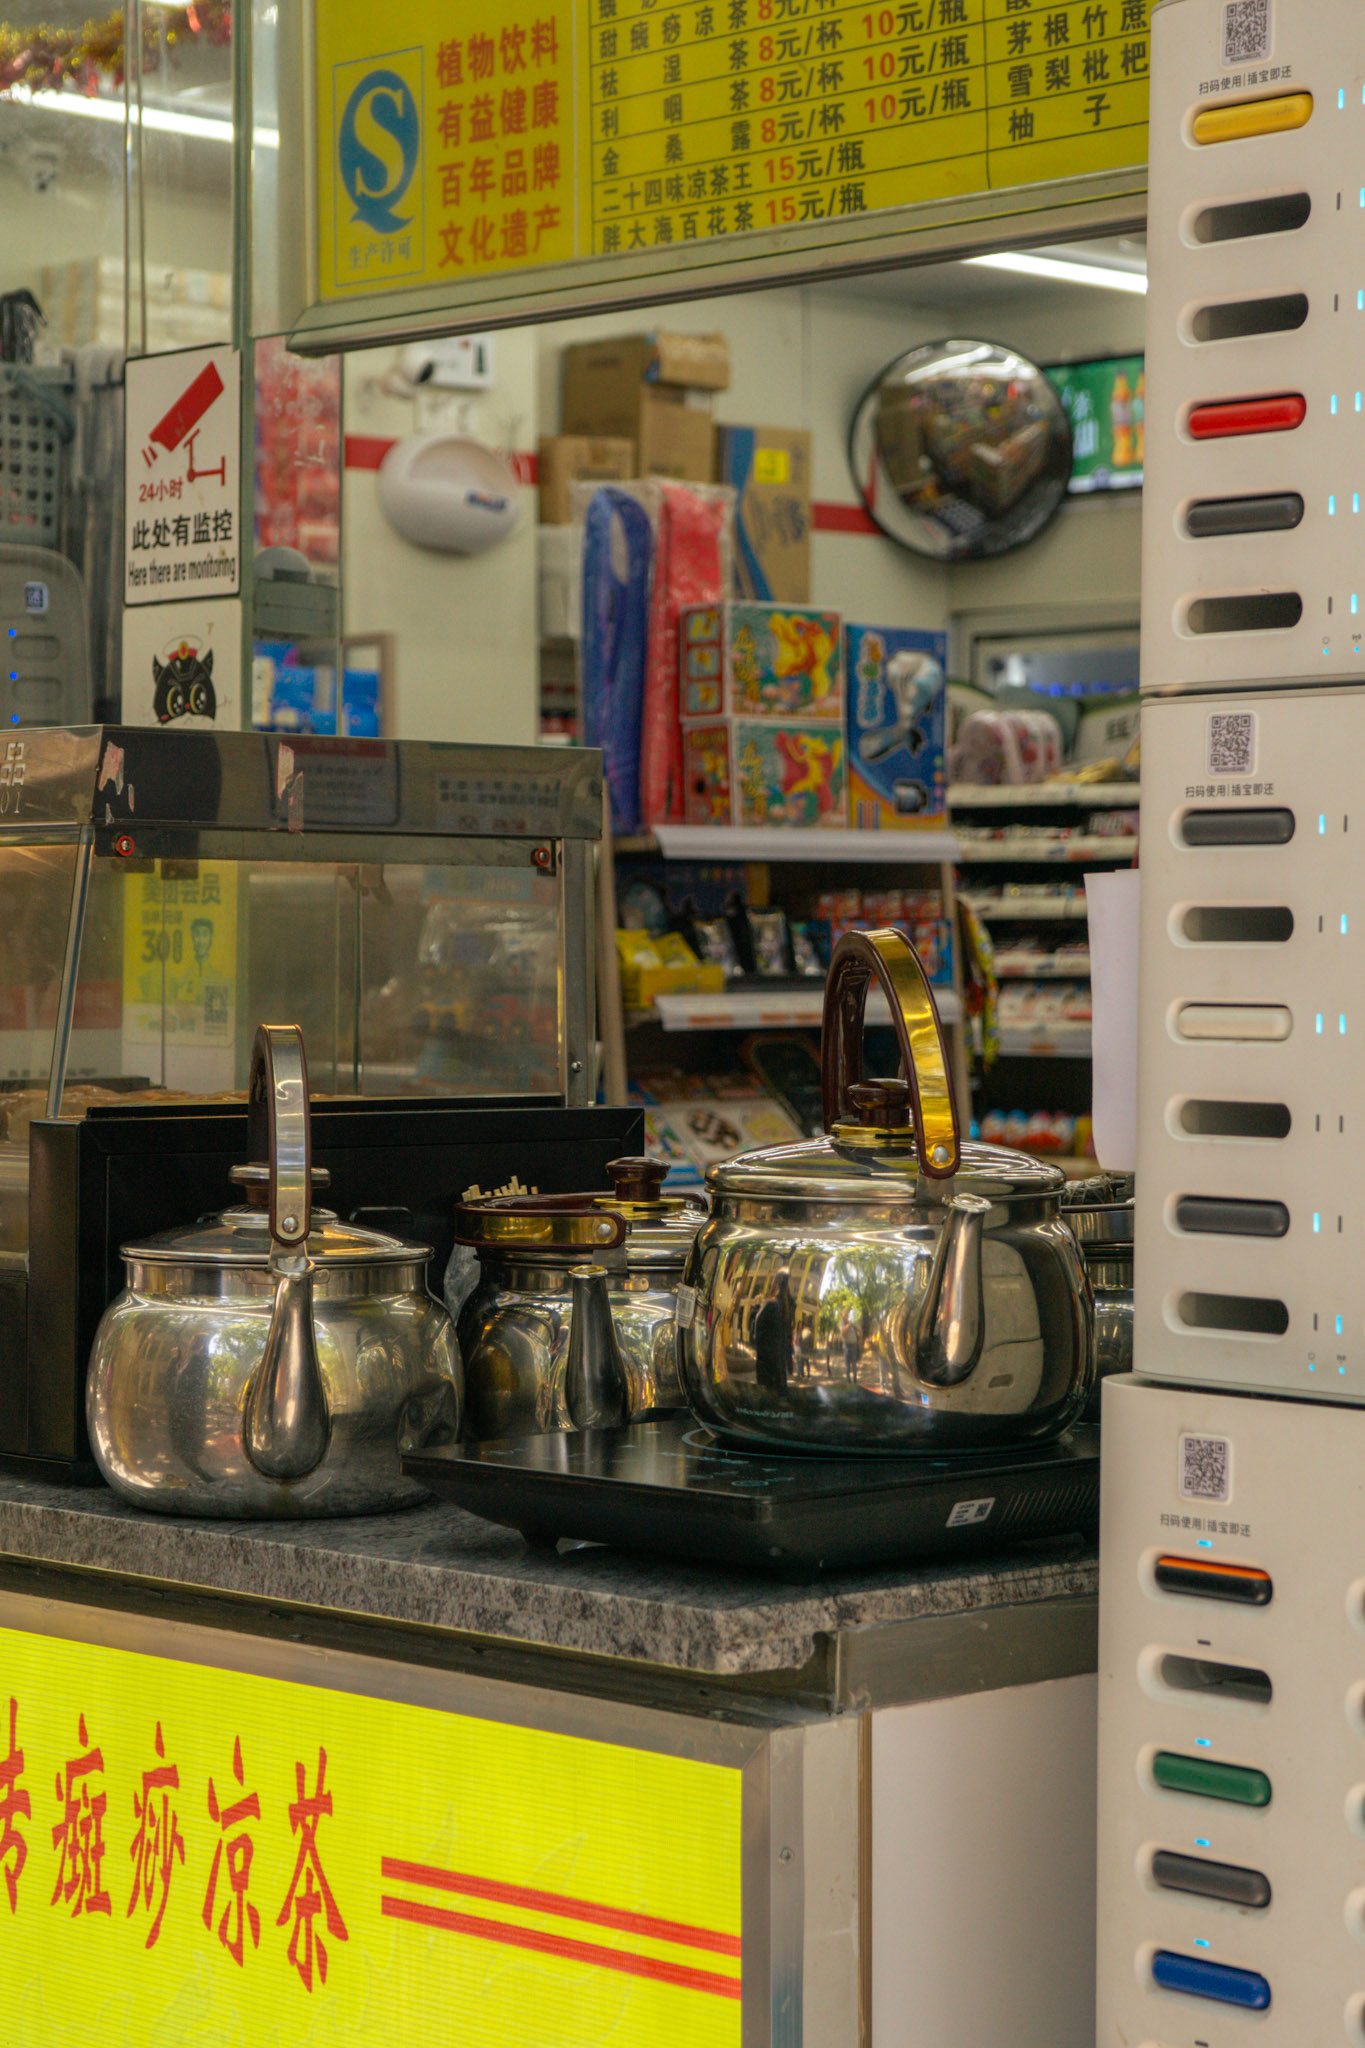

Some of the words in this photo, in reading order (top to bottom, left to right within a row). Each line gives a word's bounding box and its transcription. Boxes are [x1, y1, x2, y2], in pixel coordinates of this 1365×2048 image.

[436, 15, 559, 90] 植物饮料
[599, 38, 748, 98] 祛湿茶
[758, 18, 843, 62] 8元/杯
[861, 0, 969, 40] 10元/瓶
[1006, 0, 1148, 55] 茅根竹蔗
[600, 79, 750, 137] 利咽茶
[759, 60, 844, 102] 8元/杯
[862, 33, 971, 82] 10元/瓶
[1007, 41, 1149, 98] 雪梨枇杷
[437, 79, 560, 149] 有益健康
[601, 119, 752, 177] 金桑露
[761, 102, 846, 145] 8元/杯
[864, 76, 972, 125] 10元/瓶
[1008, 93, 1111, 142] 柚子
[438, 141, 561, 208] 百年品牌
[602, 162, 752, 213] 二十四味凉茶王
[764, 140, 866, 184] 15元/瓶
[438, 203, 561, 268] 文化遗产
[602, 201, 754, 252] 胖大海百花茶
[766, 182, 868, 224] 15元/瓶
[138, 476, 184, 503] 24小时
[131, 507, 233, 551] 此处有监控
[128, 561, 147, 587] Here
[149, 558, 171, 585] there
[173, 562, 186, 582] are
[188, 551, 236, 582] monitoring
